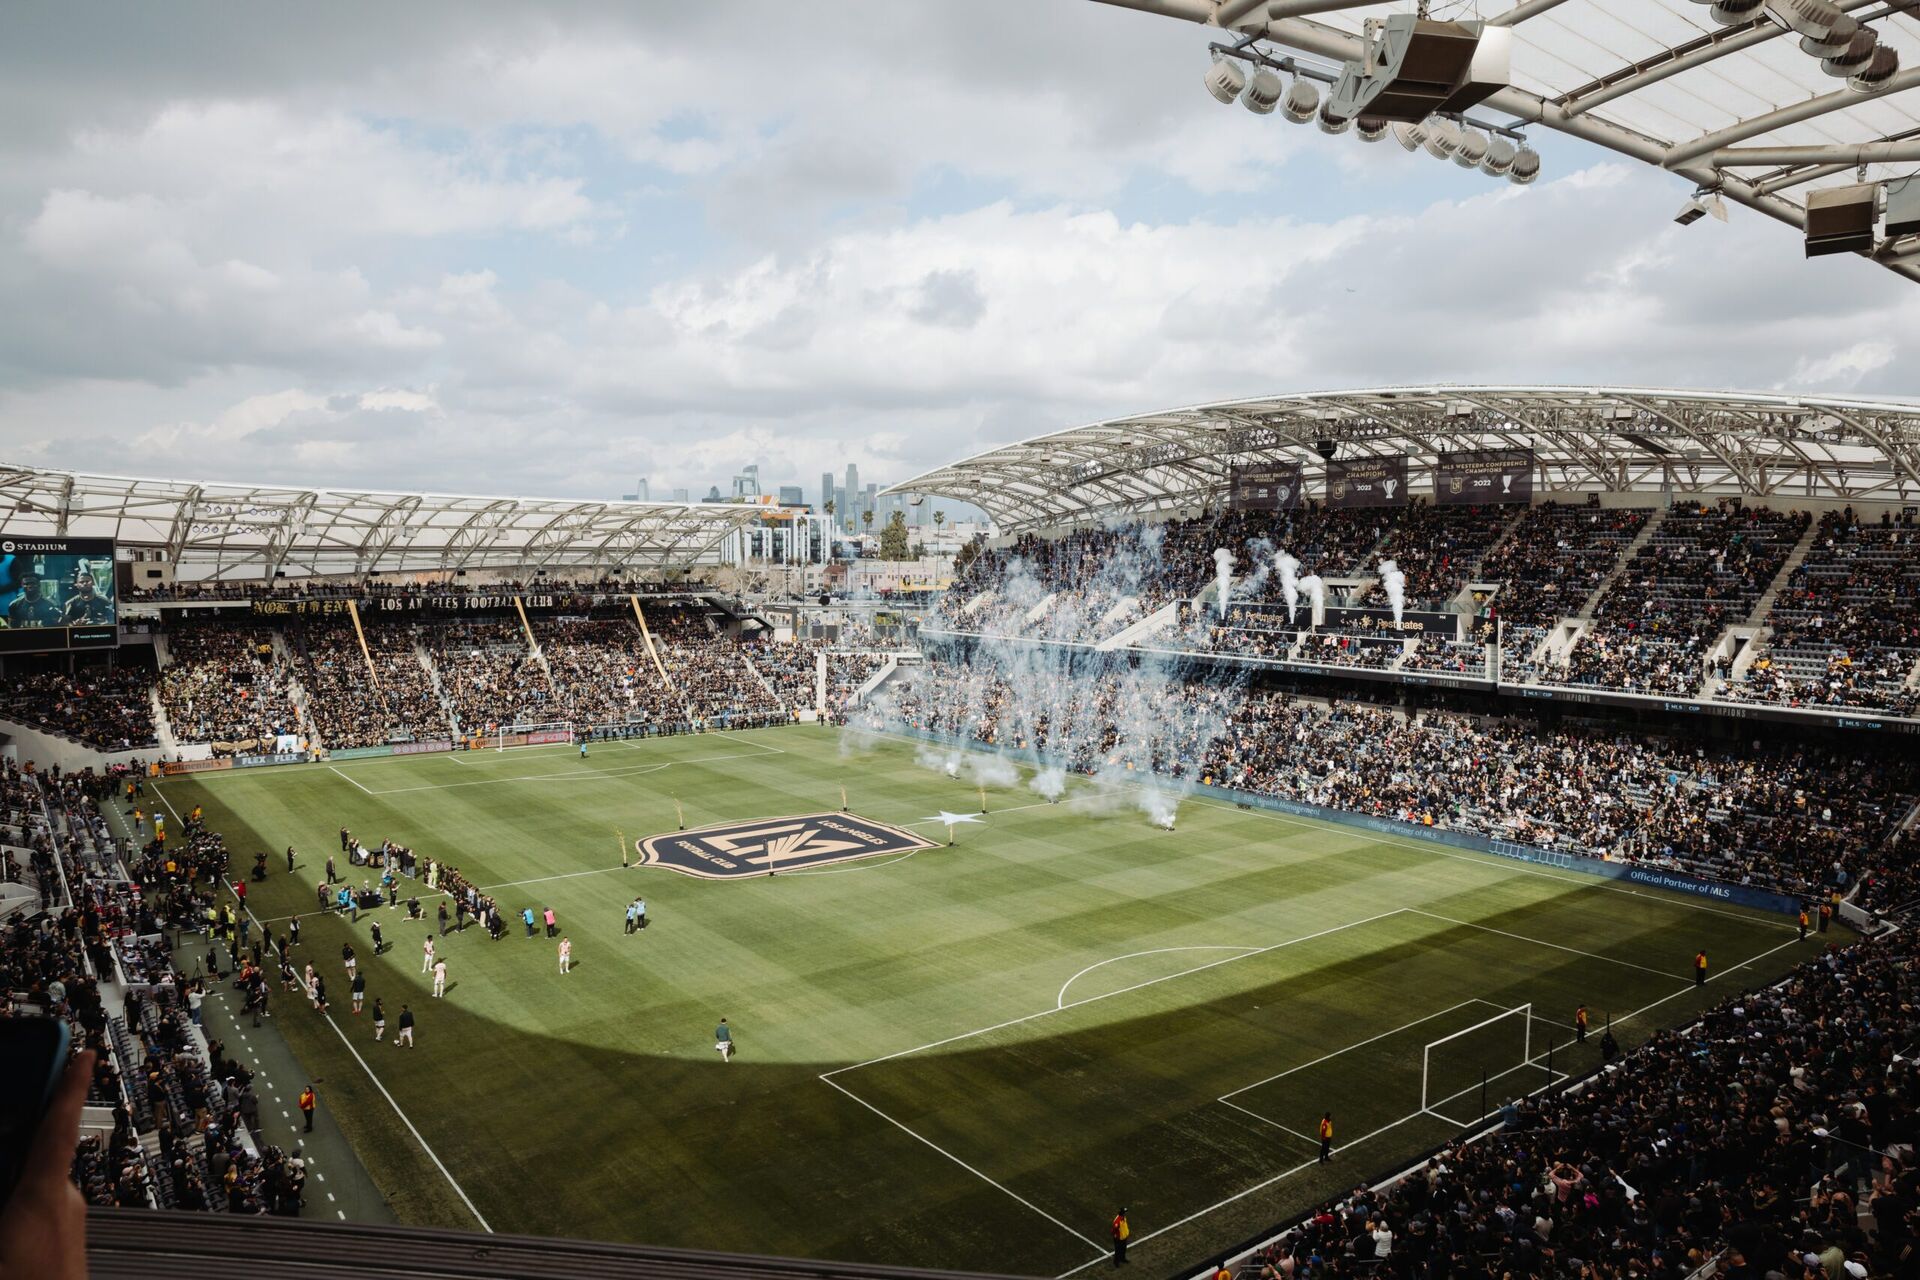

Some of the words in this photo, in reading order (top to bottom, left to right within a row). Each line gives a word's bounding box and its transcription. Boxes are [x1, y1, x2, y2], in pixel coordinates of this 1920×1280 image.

[1485, 460, 1527, 468] CONFERENCE
[1346, 470, 1386, 478] CHAMPIONS
[1465, 467, 1502, 475] CHAMPIONS
[1473, 479, 1491, 487] 2022
[17, 543, 67, 551] STADIUM
[380, 598, 402, 610] LOS
[408, 597, 458, 609] ANELES
[525, 595, 553, 608] CLUB
[1377, 618, 1424, 631] Pstates
[1708, 705, 1747, 718] AMPIONS
[242, 756, 266, 765] FLEX
[275, 754, 298, 763] FLEX
[164, 760, 214, 773] ontinental
[1279, 801, 1321, 816] Management
[1367, 820, 1391, 833] Official
[1391, 825, 1415, 835] Partner
[1423, 831, 1438, 840] MLS
[675, 840, 715, 860] FOOTBALL
[710, 858, 738, 869] CLUB
[1630, 871, 1662, 885] Official
[1663, 877, 1697, 891] Partner
[1698, 884, 1710, 894] of
[1709, 886, 1730, 898] MLS
